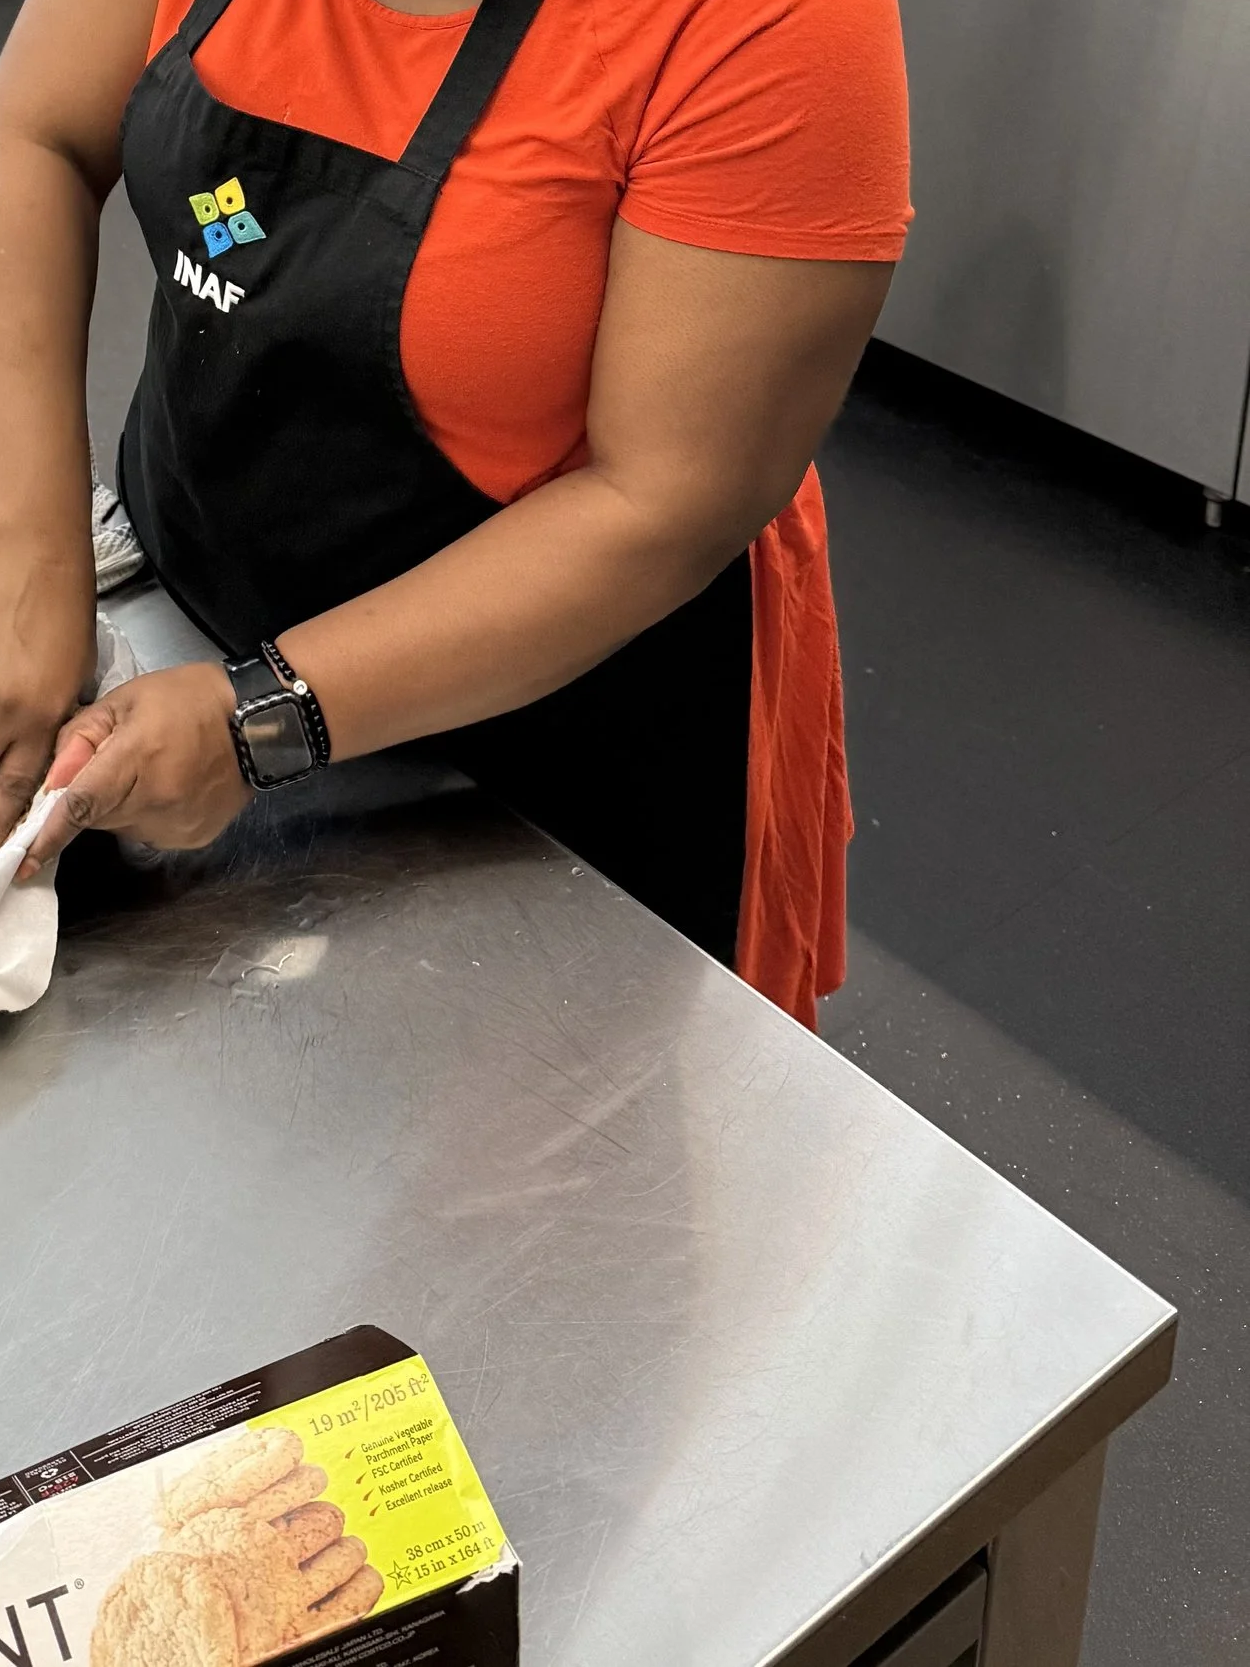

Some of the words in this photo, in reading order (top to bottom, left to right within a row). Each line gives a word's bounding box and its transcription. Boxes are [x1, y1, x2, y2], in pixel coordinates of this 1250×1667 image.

[173, 248, 246, 313] INAF
[309, 1414, 333, 1436] 19
[360, 1434, 395, 1453] Genuine
[394, 1418, 433, 1441] Vegetable
[366, 1442, 410, 1465] Parchment
[410, 1432, 434, 1452] Paper
[371, 1464, 390, 1479] FSC
[389, 1451, 423, 1472] Certified
[379, 1477, 408, 1496] Kosher
[409, 1463, 443, 1484] Certified
[385, 1488, 424, 1512] Excellent
[423, 1477, 453, 1497] release
[405, 1545, 425, 1561] 38
[425, 1538, 444, 1554] cm
[454, 1525, 471, 1541] 50
[472, 1521, 486, 1534] m
[414, 1564, 430, 1580] 15
[432, 1559, 446, 1574] in
[459, 1543, 481, 1562] 164
[483, 1536, 496, 1553] ft
